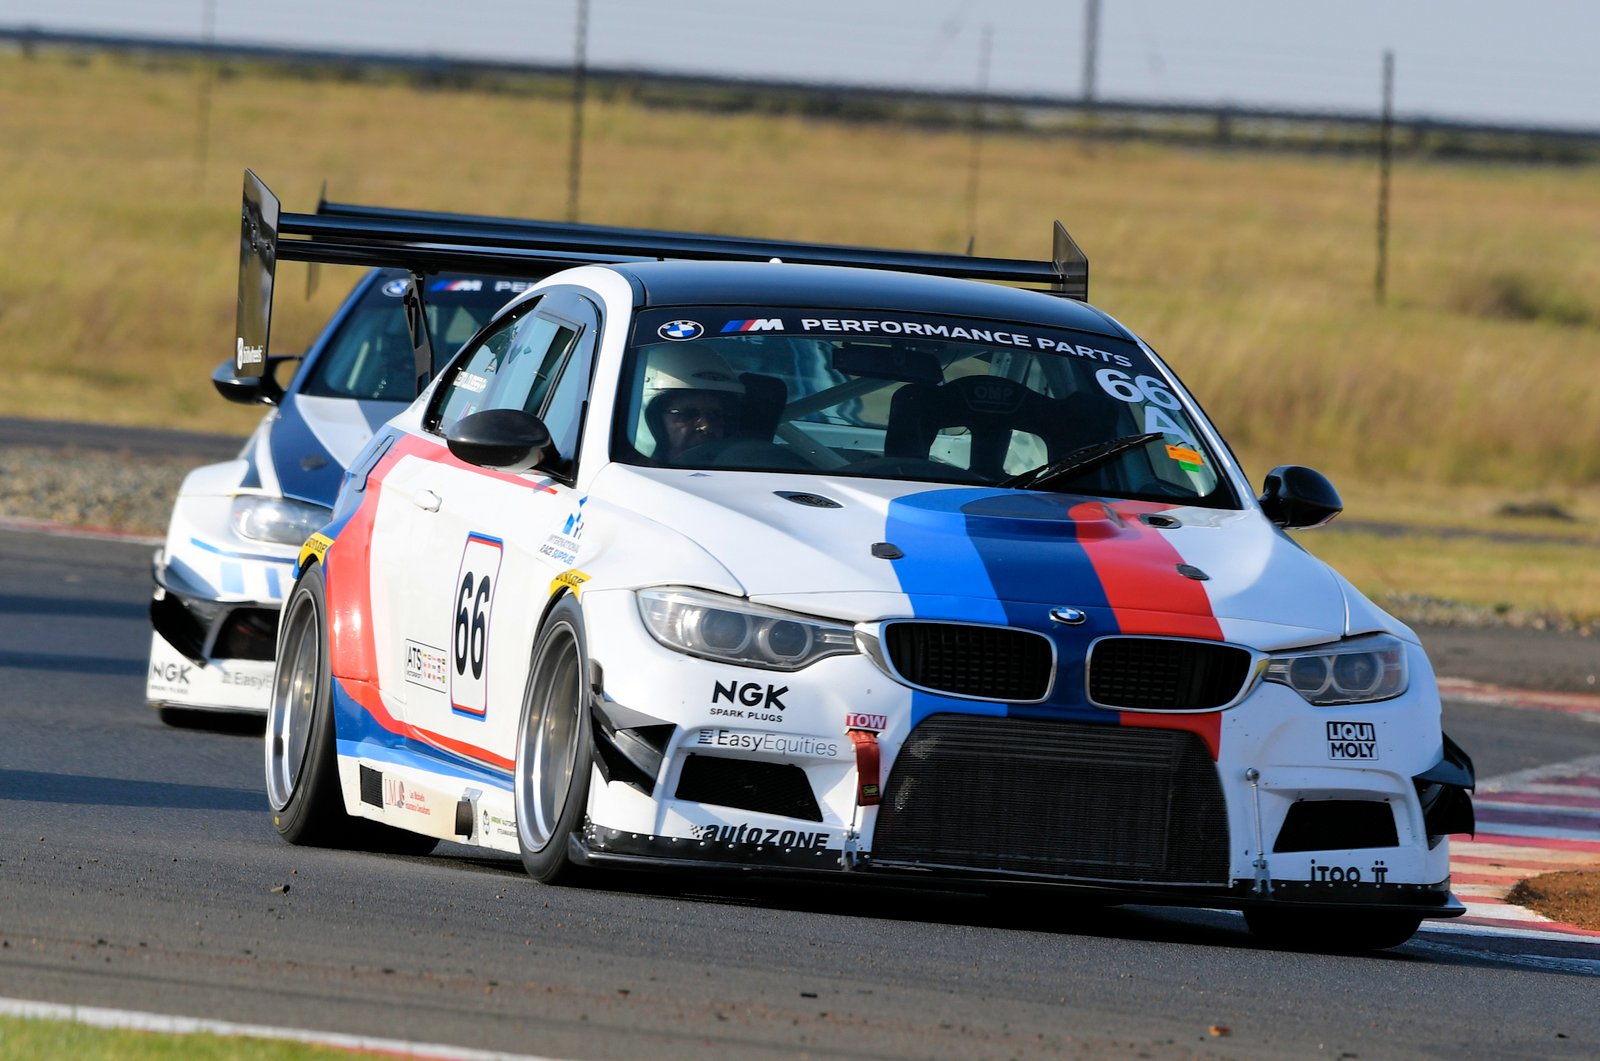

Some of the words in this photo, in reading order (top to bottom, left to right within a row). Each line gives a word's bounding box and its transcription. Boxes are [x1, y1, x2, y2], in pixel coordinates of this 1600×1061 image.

[801, 318, 1032, 348] PERFORMANCE
[1037, 337, 1133, 367] PARTS
[1095, 368, 1182, 411] 66
[1144, 406, 1197, 447] A
[454, 571, 491, 681] 66
[406, 645, 422, 671] ATS
[150, 662, 192, 685] NGK
[712, 680, 789, 711] NGK
[709, 708, 745, 718] SPARK
[747, 711, 783, 722] PLUGS
[847, 713, 886, 729] TOW
[717, 729, 838, 756] EasyEquities
[1328, 723, 1374, 740] LIQUI
[1330, 742, 1375, 758] MOLY
